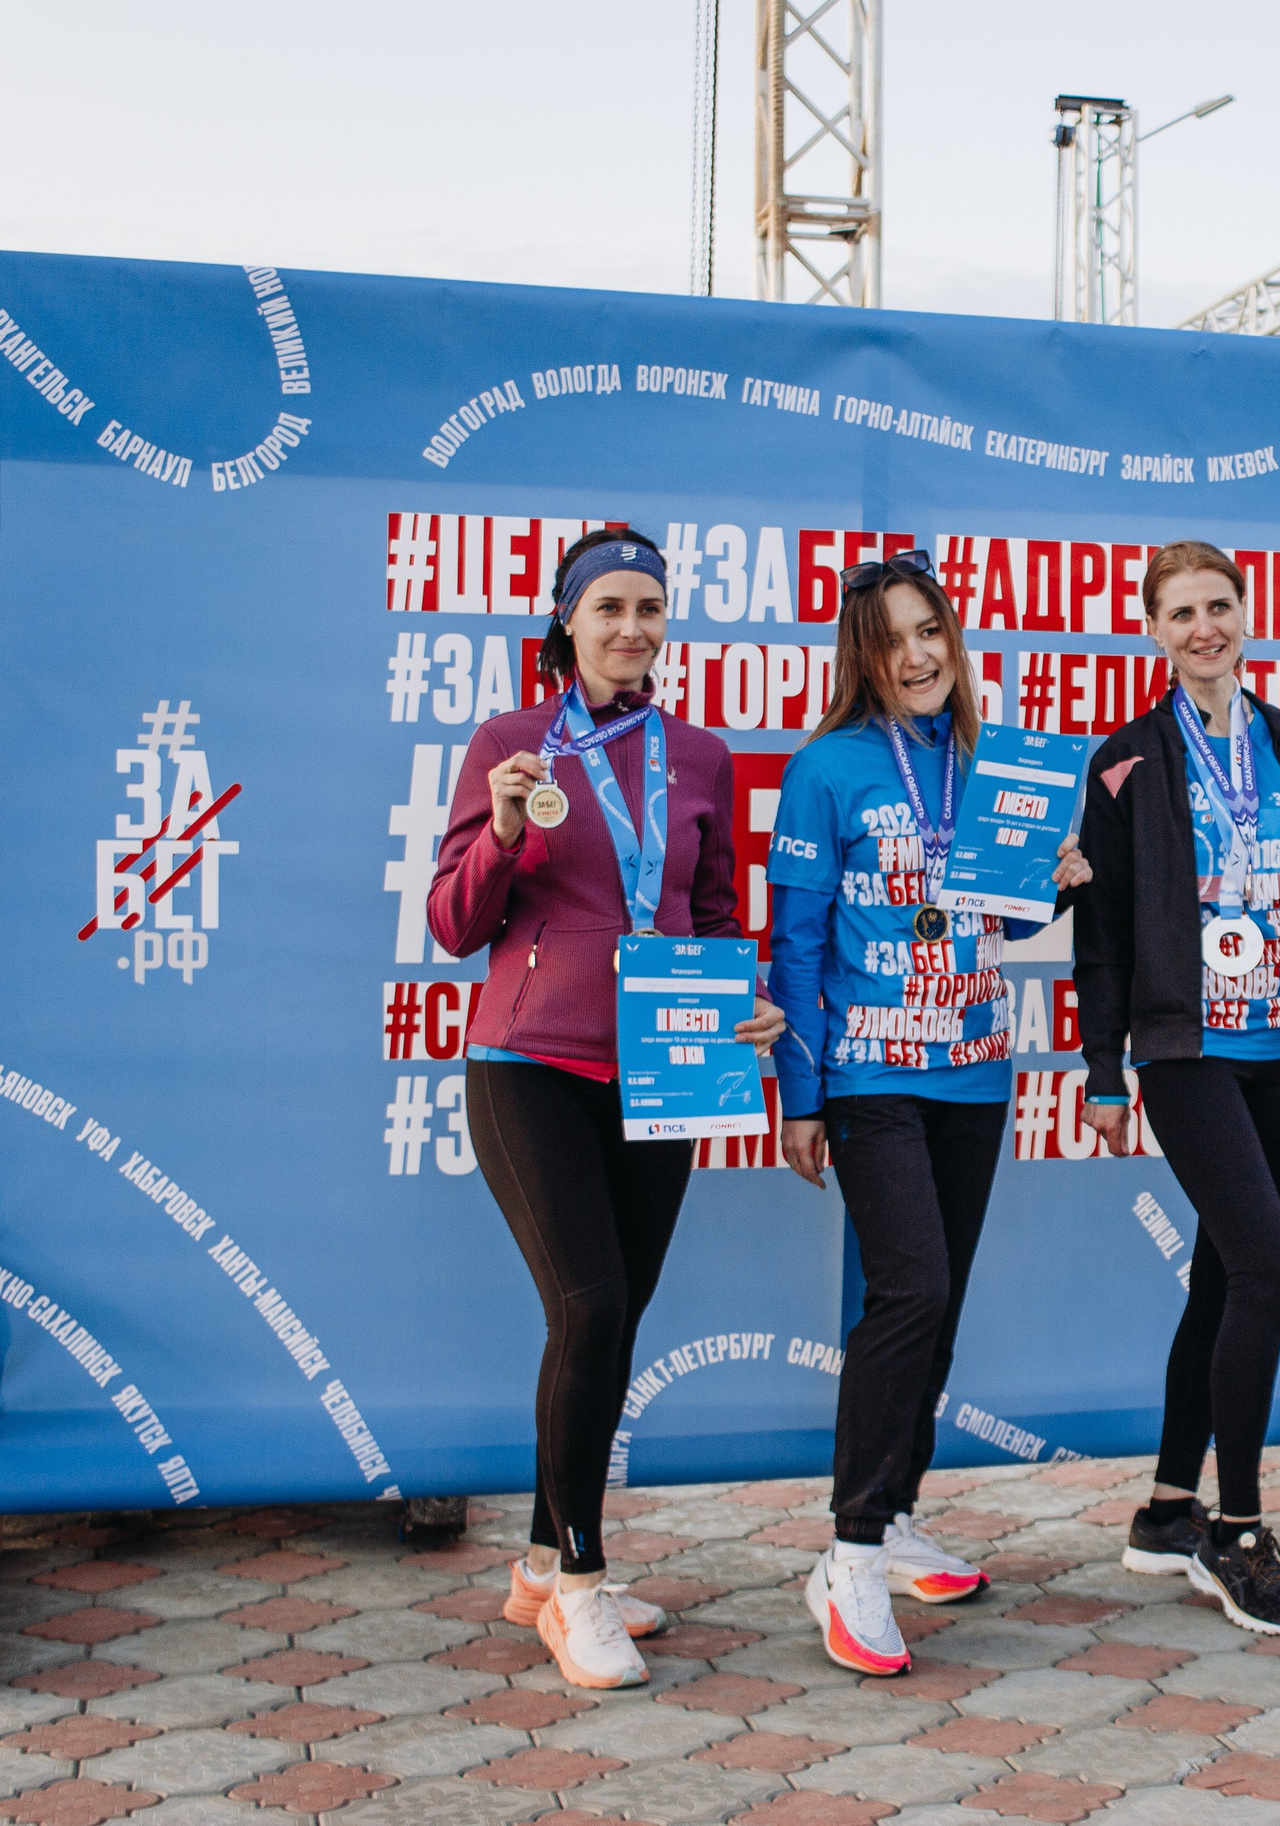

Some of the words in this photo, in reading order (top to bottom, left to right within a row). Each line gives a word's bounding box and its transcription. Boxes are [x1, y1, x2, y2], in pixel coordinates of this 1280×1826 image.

[256, 295, 312, 395] ВЕЛИКИЙ
[97, 419, 193, 489] БАРНАУЛ
[210, 411, 312, 492] БЕЛГОРОД
[422, 380, 526, 469] ВОЛГОГРАД
[532, 364, 622, 400] ВОЛОГДА
[636, 365, 729, 400] ВОРОНЕЖ
[742, 377, 820, 416] ГАТЧИНА
[833, 394, 975, 452] ГОРНО-АЛТАЙСК
[985, 430, 1110, 477] ЕКАТЕРИНБУРГ
[1121, 452, 1196, 484] ЗАРАЙСК
[1207, 445, 1280, 483] ИЖЕВСК
[1179, 702, 1211, 758] САХАЛИНСКАЯ
[1207, 752, 1230, 792] ОБЛАСТЬ
[115, 748, 221, 839] ЗА
[907, 776, 925, 819] ОБЛАСТЬ
[1001, 791, 1049, 820] МЕСТО
[777, 835, 818, 860] ПСБ
[96, 839, 240, 930] БЕГ
[967, 898, 986, 907] ПСБ
[1004, 904, 1031, 912] FONBET
[864, 939, 957, 977] #ЗАБЕГ
[670, 1008, 720, 1032] МЕСТО
[845, 1004, 966, 1042] #ЛЮБОВЬ
[835, 1038, 929, 1070] #ЗАБЕГ
[663, 1124, 687, 1133] ПСБ
[1132, 1191, 1185, 1260] ТЮМЕНЬ
[76, 1117, 123, 1162] УФА
[119, 1150, 216, 1242] ХАБАРОВСК
[207, 1234, 331, 1381] ХАНТЫ-МАНСИЙСК
[320, 1379, 391, 1484] ЧЕЛЯБИНСК
[623, 1333, 775, 1419] САНКТ-ПЕТЕРБУРГ
[111, 1384, 172, 1456] ЯКУТСК
[157, 1454, 201, 1505] ЯЛТА
[955, 1403, 1046, 1461] СМОЛЕНСК
